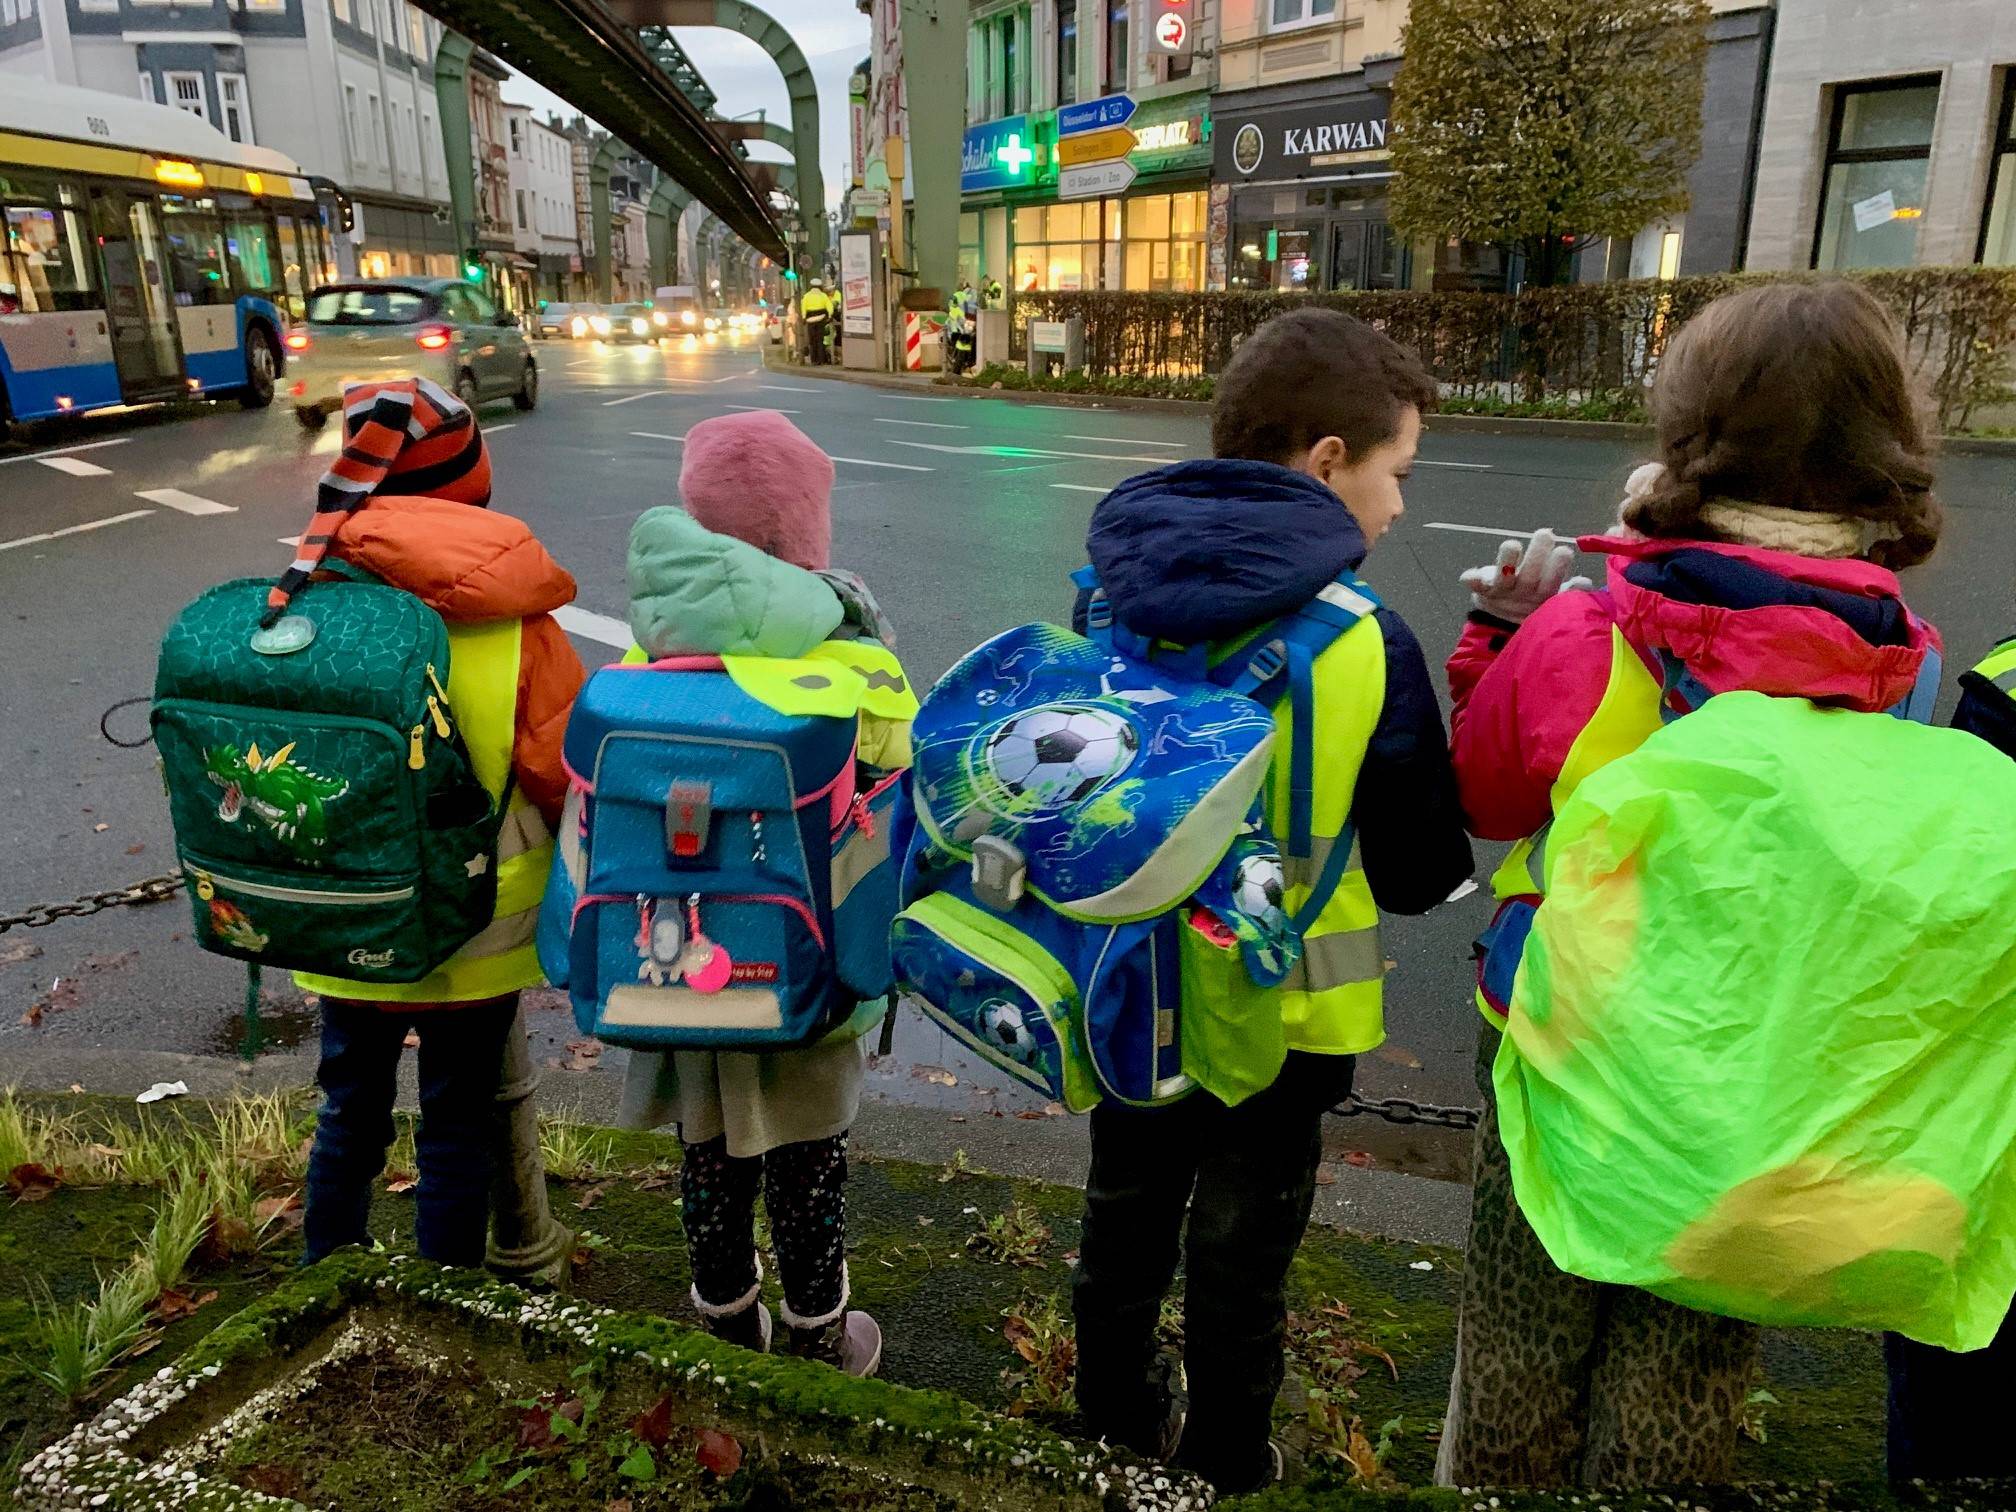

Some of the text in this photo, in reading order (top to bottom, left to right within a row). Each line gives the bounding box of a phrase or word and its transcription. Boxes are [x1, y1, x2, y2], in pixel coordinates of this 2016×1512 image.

[1283, 119, 1387, 156] KARWAN
[1078, 175, 1101, 187] Stadion
[1108, 171, 1120, 183] Zoo
